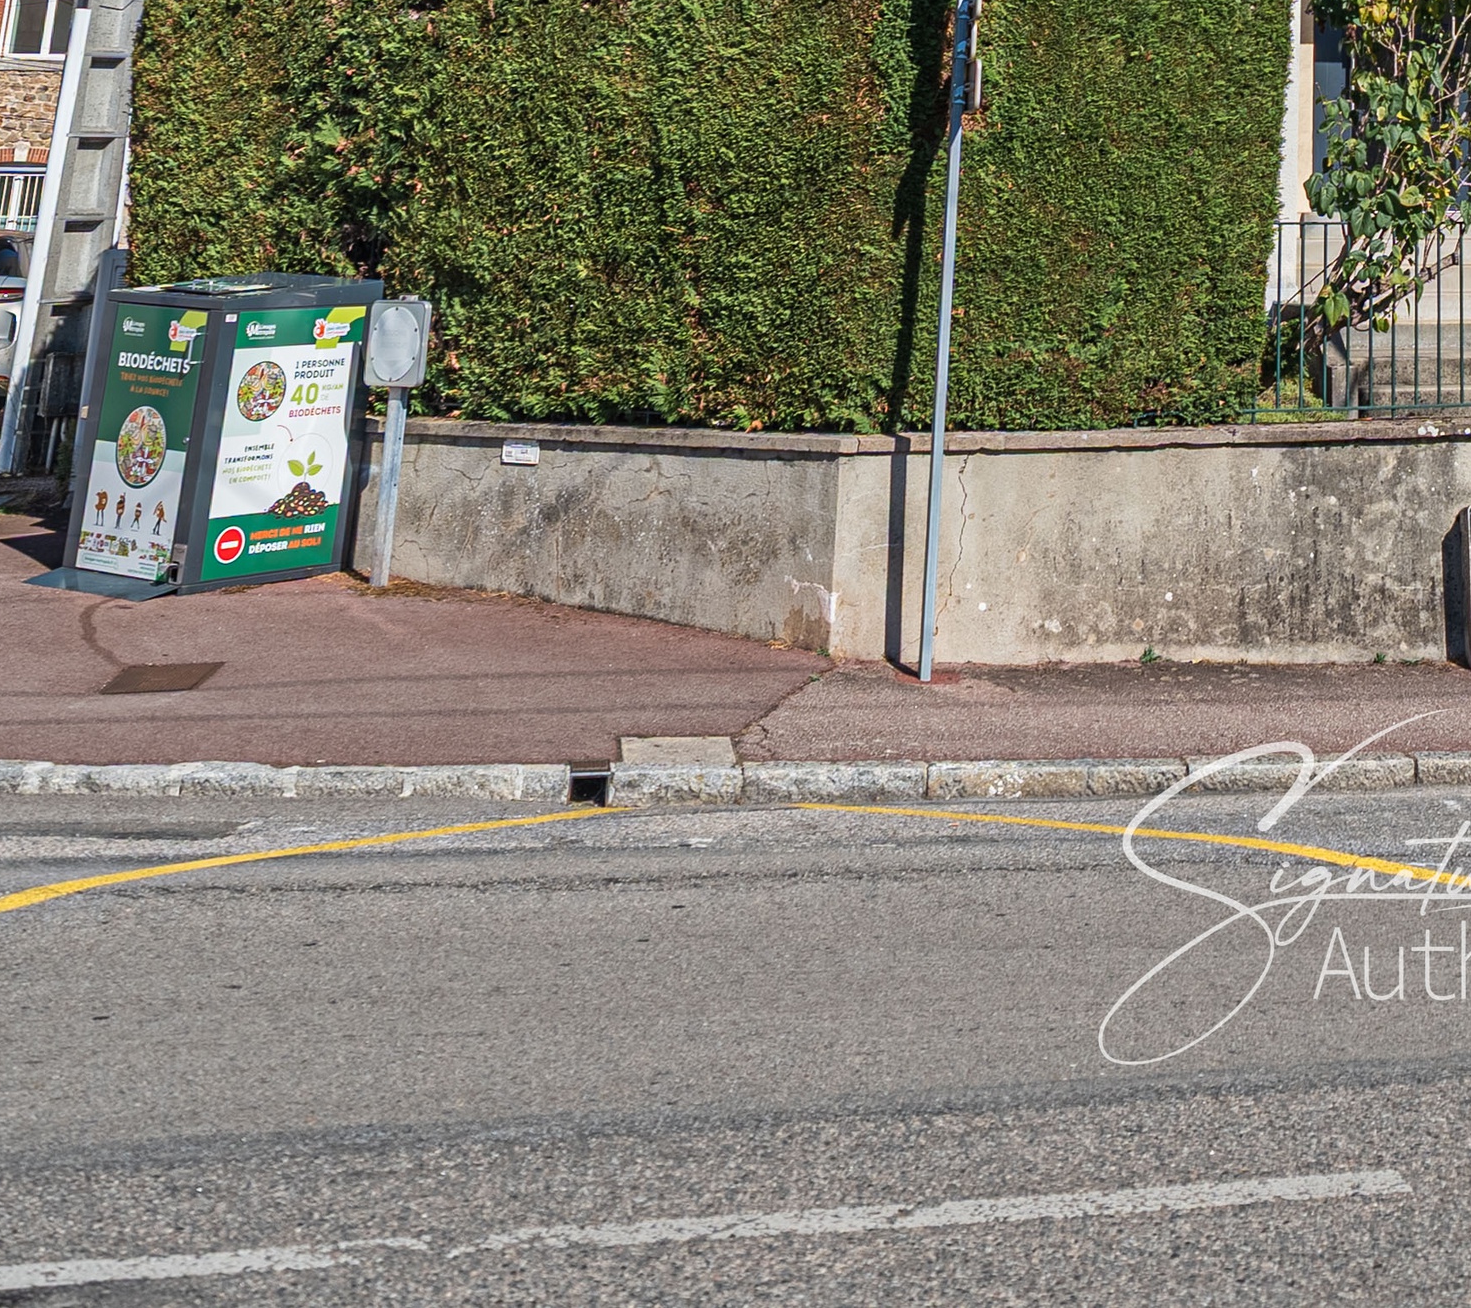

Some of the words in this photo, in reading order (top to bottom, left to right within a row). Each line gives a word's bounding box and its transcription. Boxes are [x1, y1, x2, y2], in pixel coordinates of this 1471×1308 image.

[118, 351, 190, 374] BIODÉCHETS
[301, 358, 345, 368] PERSONNE
[294, 369, 334, 380] PRODUIT
[290, 383, 319, 405] 40
[289, 405, 341, 417] BIODÉCHETS
[244, 443, 275, 452] ENSEMBLE
[224, 453, 273, 464] TRANSFORMONS
[304, 523, 325, 534] RIEN
[248, 541, 288, 555] DÉPOSER
